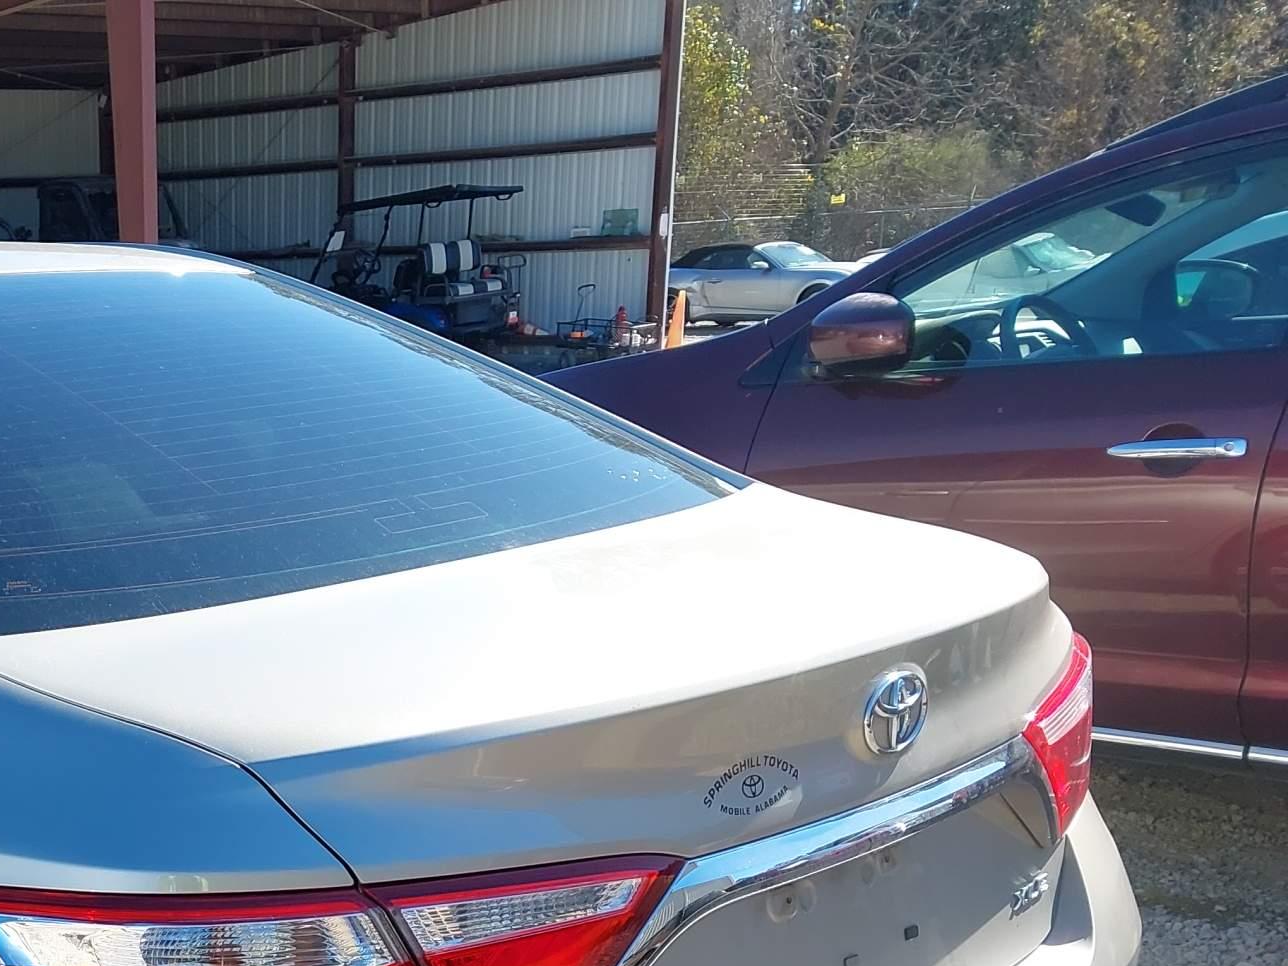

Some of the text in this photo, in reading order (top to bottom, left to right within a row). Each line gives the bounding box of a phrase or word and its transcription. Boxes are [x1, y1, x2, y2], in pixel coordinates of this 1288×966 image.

[703, 754, 800, 809] SPRINGHILL TOYOTA
[719, 785, 789, 816] MOBILE ALABAMA
